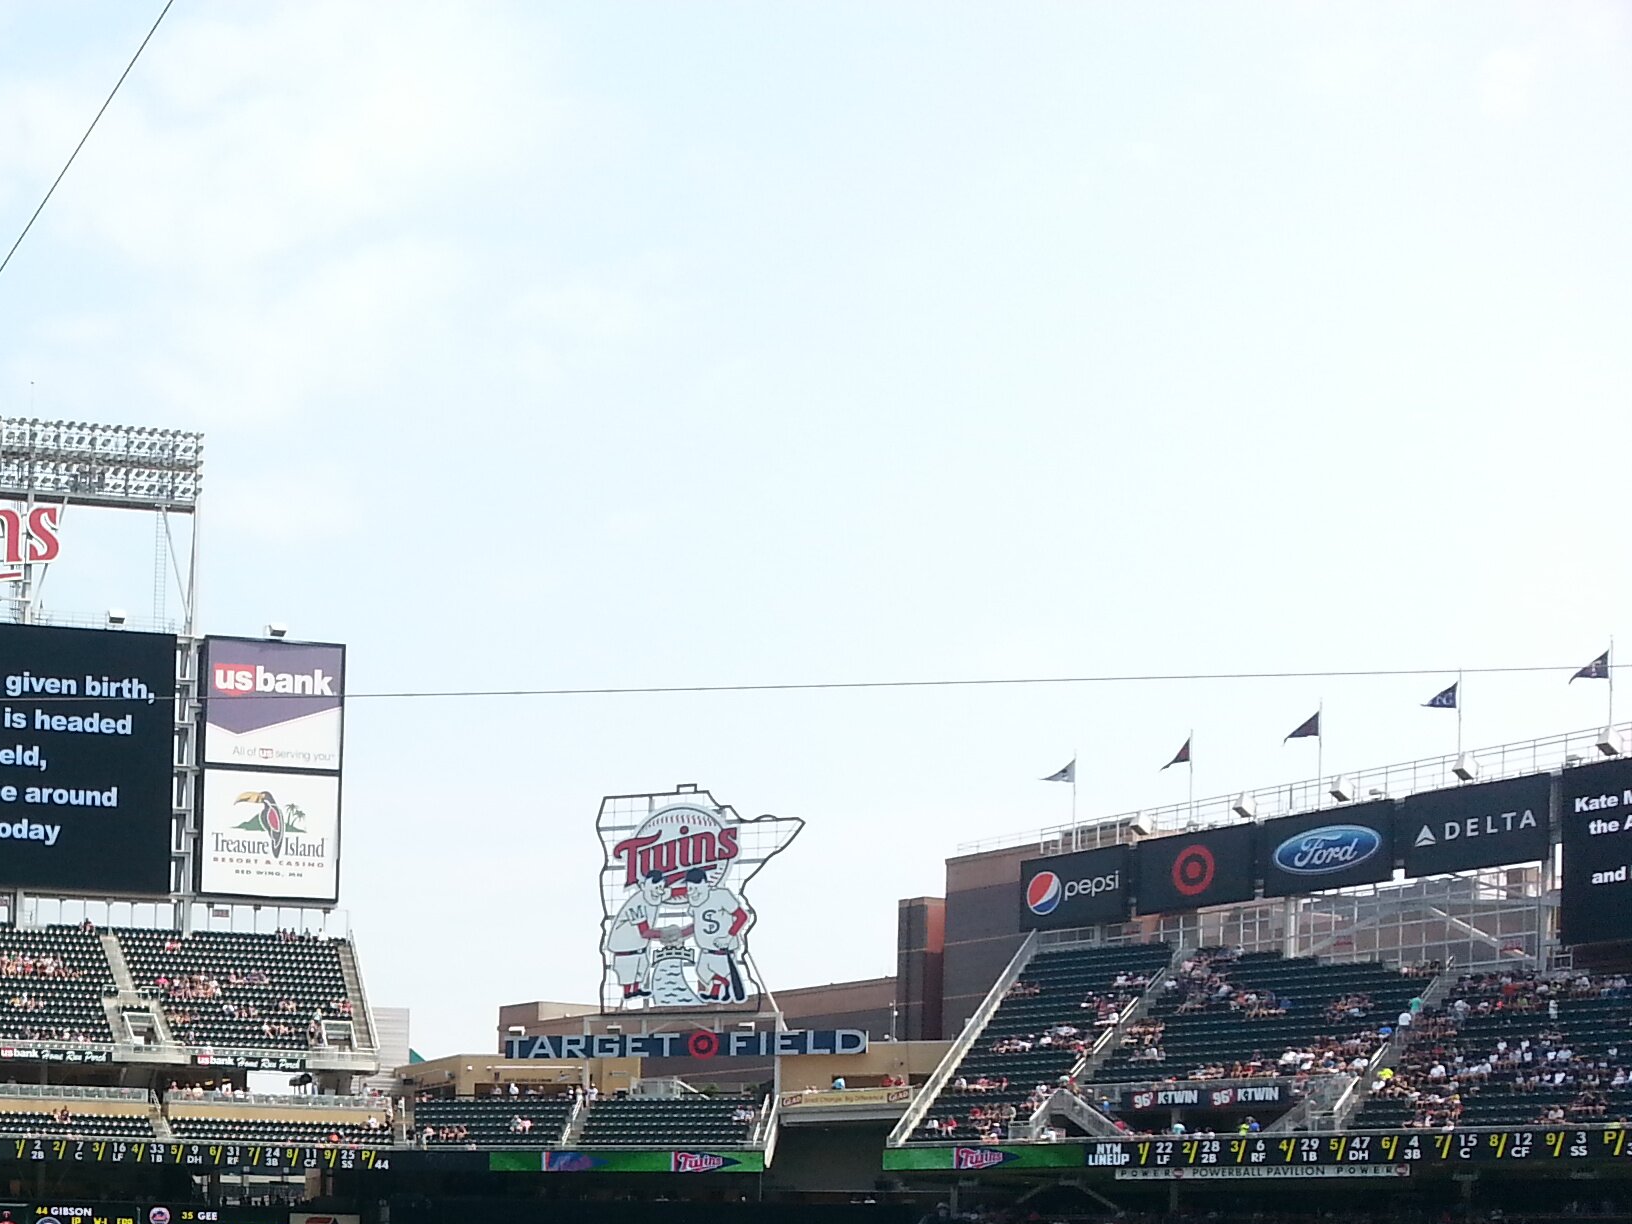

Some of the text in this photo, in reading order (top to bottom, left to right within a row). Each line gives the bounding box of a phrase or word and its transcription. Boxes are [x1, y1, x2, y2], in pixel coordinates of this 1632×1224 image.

[5, 671, 77, 696] given
[85, 675, 155, 704] birth,
[4, 707, 27, 729] is
[34, 708, 132, 735] headed
[24, 786, 118, 807] around
[1574, 794, 1619, 813] Kate
[1444, 809, 1537, 841] DELTA
[1588, 819, 1620, 835] the
[211, 832, 325, 858] Treasure Island
[1293, 837, 1359, 868] Ford
[613, 825, 739, 887] Twins
[1591, 865, 1627, 885] and
[1064, 871, 1120, 901] pepsi
[506, 1029, 867, 1059] TARGET FIELD
[33, 1140, 355, 1160] 2 7 16 33 9 31 24 11 25
[1096, 1143, 1122, 1154] NYM
[1156, 1131, 1587, 1154] 22 28 6 29 47 4 15 12 3
[31, 1151, 389, 1169] 2B C LF 1B DH RF 3B CF SS 44
[679, 1152, 723, 1172] Twins
[959, 1148, 1003, 1168] Twins
[1088, 1154, 1130, 1165] LINEUP
[1156, 1145, 1588, 1165] LF 2B RF 1B DH 3B C CF SS
[1192, 1167, 1262, 1177] POWERBALL
[1266, 1166, 1325, 1177] PAVILION
[35, 1206, 93, 1217] 44 GIBSON
[181, 1212, 218, 1221] 35 GEE
